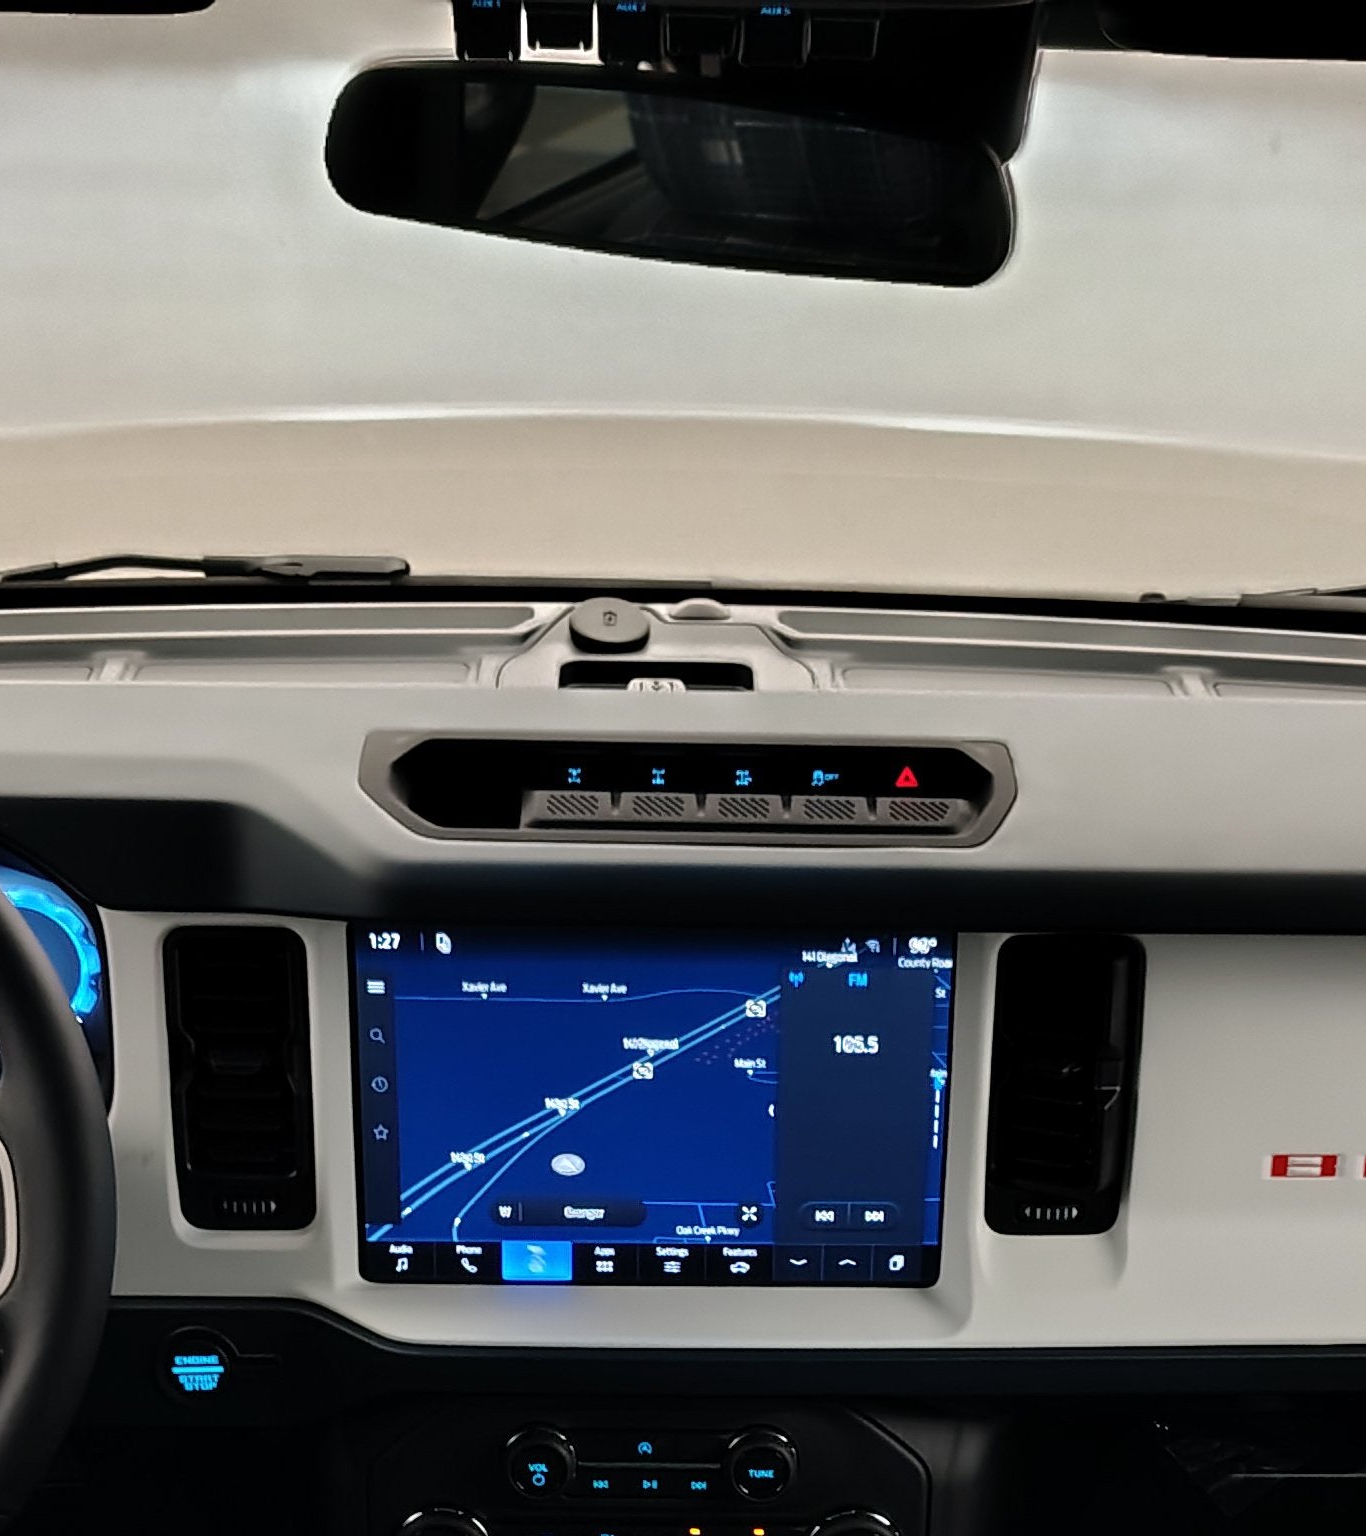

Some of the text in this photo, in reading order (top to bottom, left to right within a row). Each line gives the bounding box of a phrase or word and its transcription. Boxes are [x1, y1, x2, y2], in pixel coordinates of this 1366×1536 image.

[368, 932, 401, 950] 1:27
[897, 957, 930, 969] County
[848, 972, 868, 987] FM
[832, 1034, 880, 1054] 105.5
[734, 1058, 767, 1069] Main St
[498, 1205, 512, 1219] W
[675, 1225, 692, 1236] Oak
[693, 1225, 716, 1236] Creek
[389, 1244, 414, 1255] Audio
[455, 1244, 483, 1255] Phone
[655, 1246, 690, 1258] Settings
[722, 1246, 758, 1258] Features
[528, 1463, 549, 1473] VOL
[748, 1469, 775, 1479] TUNE
